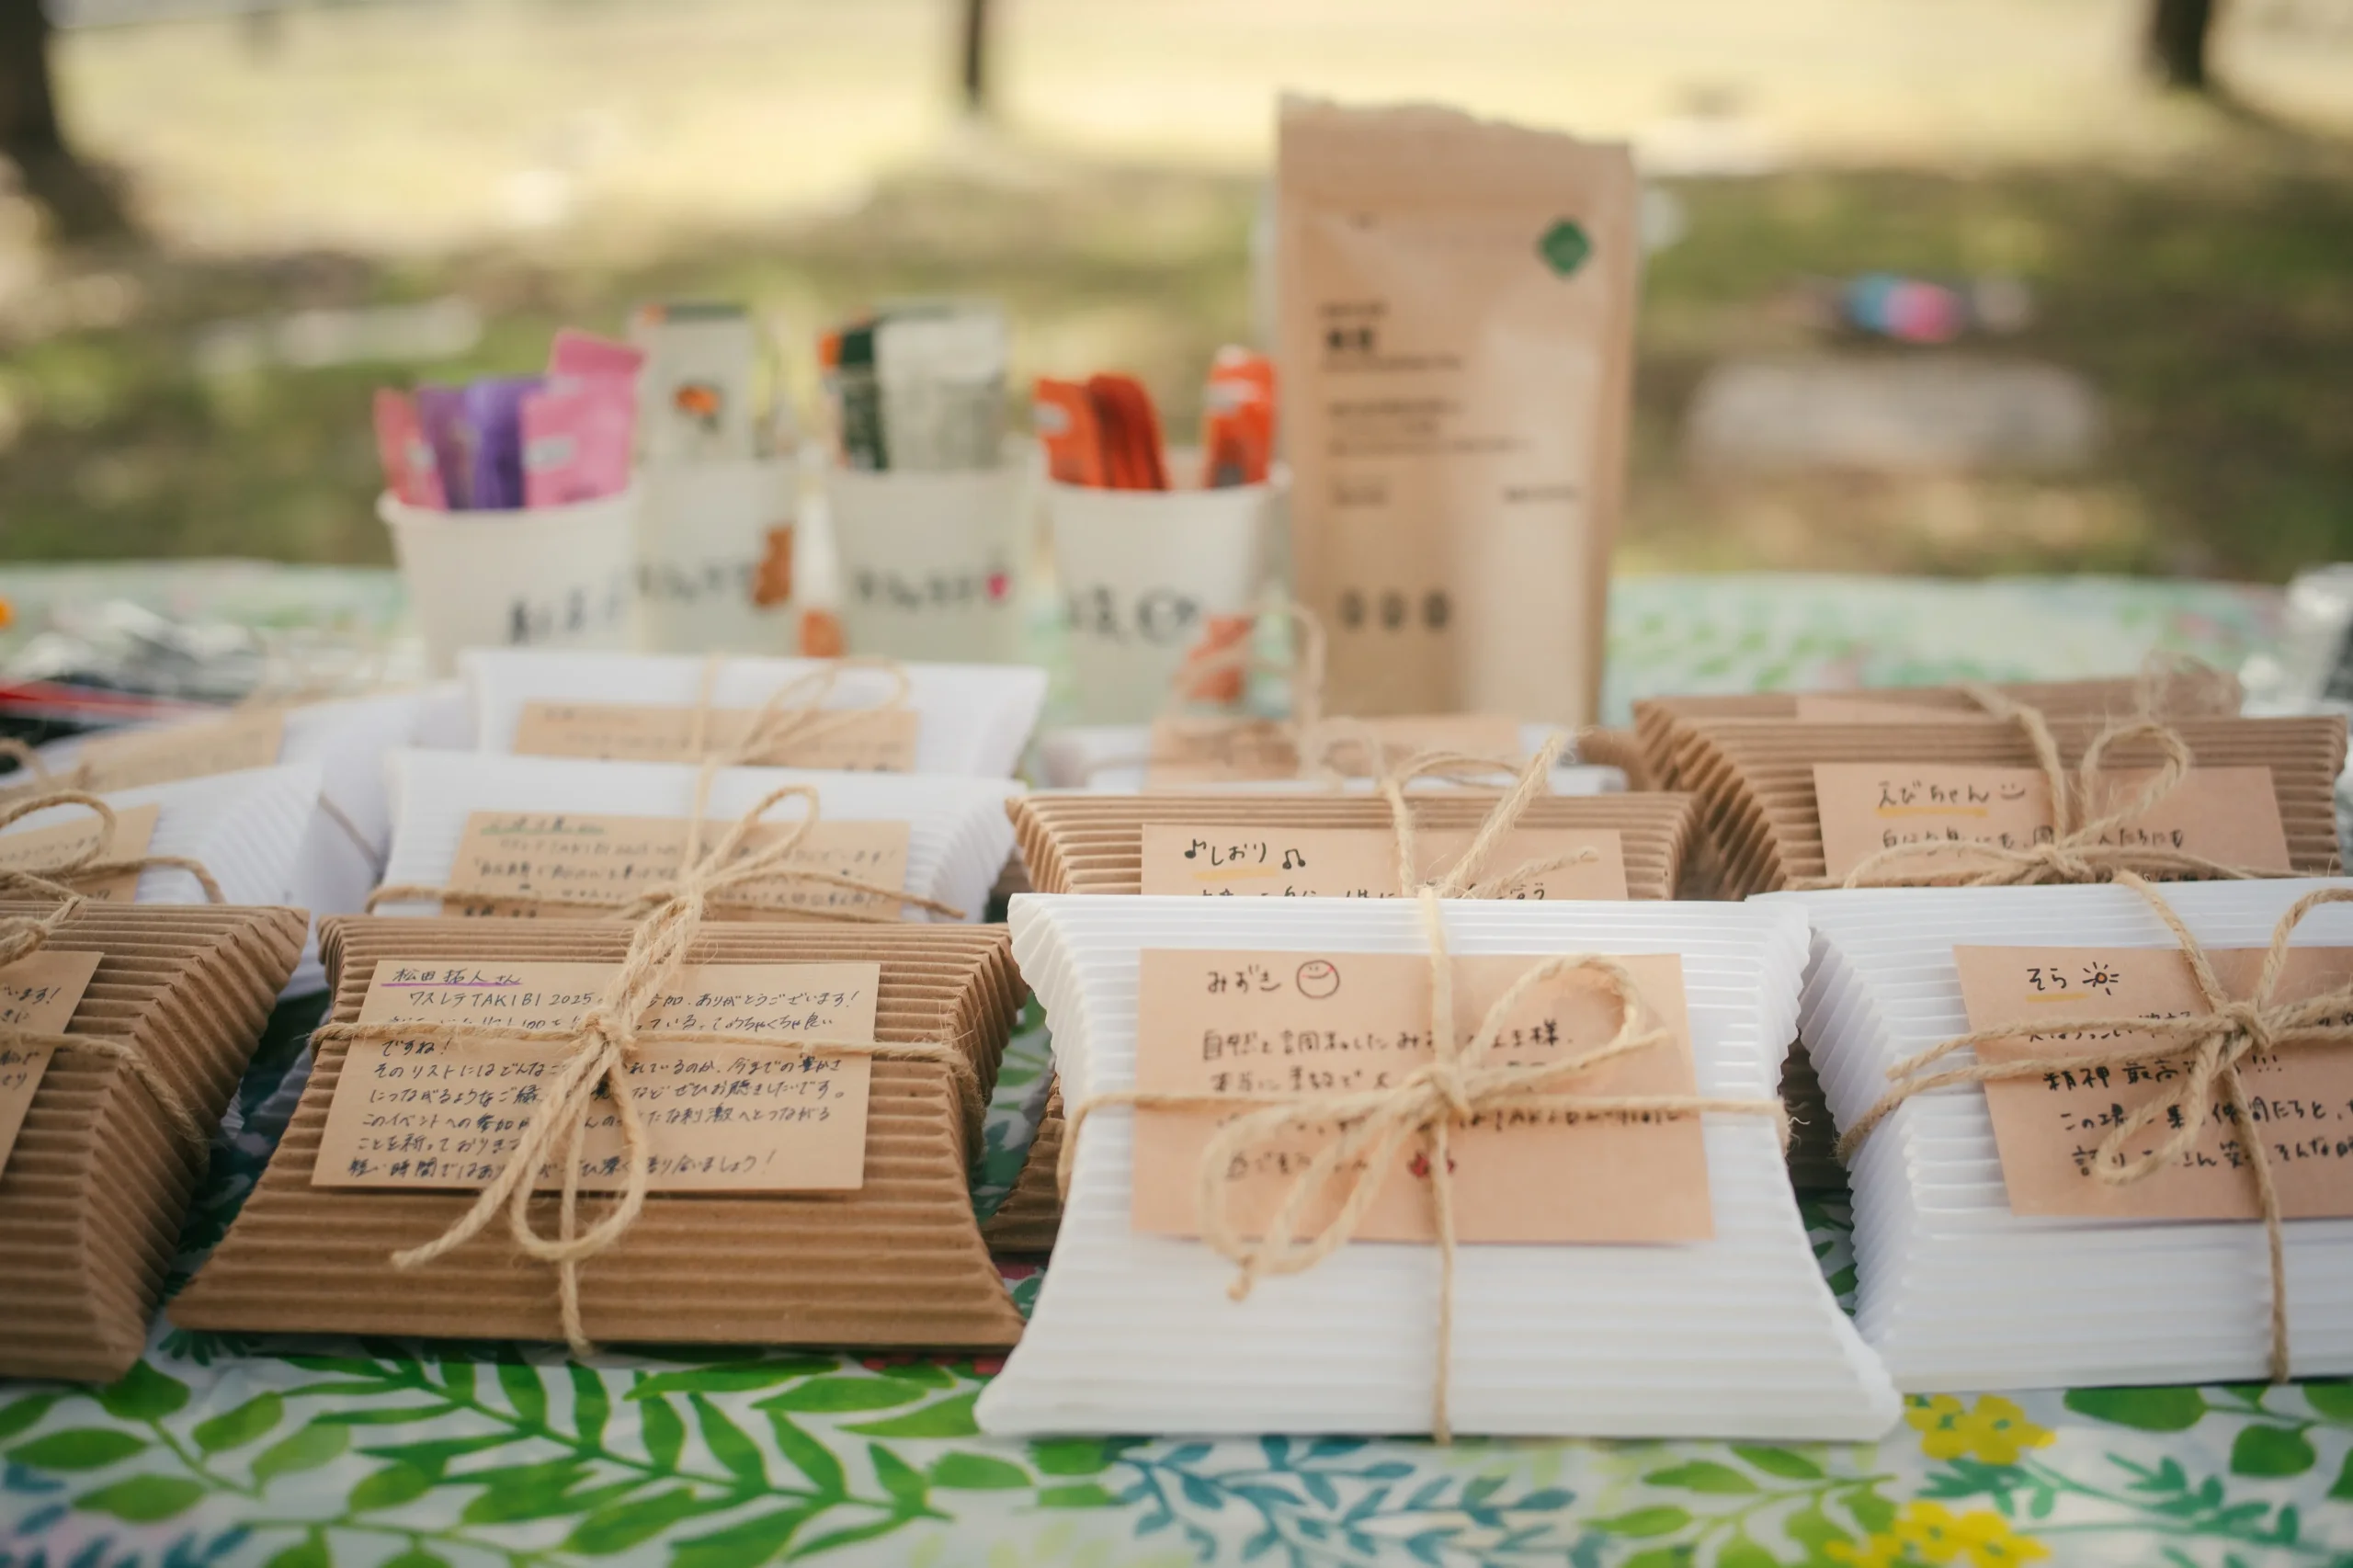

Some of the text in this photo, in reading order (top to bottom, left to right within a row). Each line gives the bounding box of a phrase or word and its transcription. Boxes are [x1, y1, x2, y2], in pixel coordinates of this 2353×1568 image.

[1212, 842, 1267, 867] しおり
[2026, 967, 2067, 991] そら
[549, 991, 595, 1006] 2025
